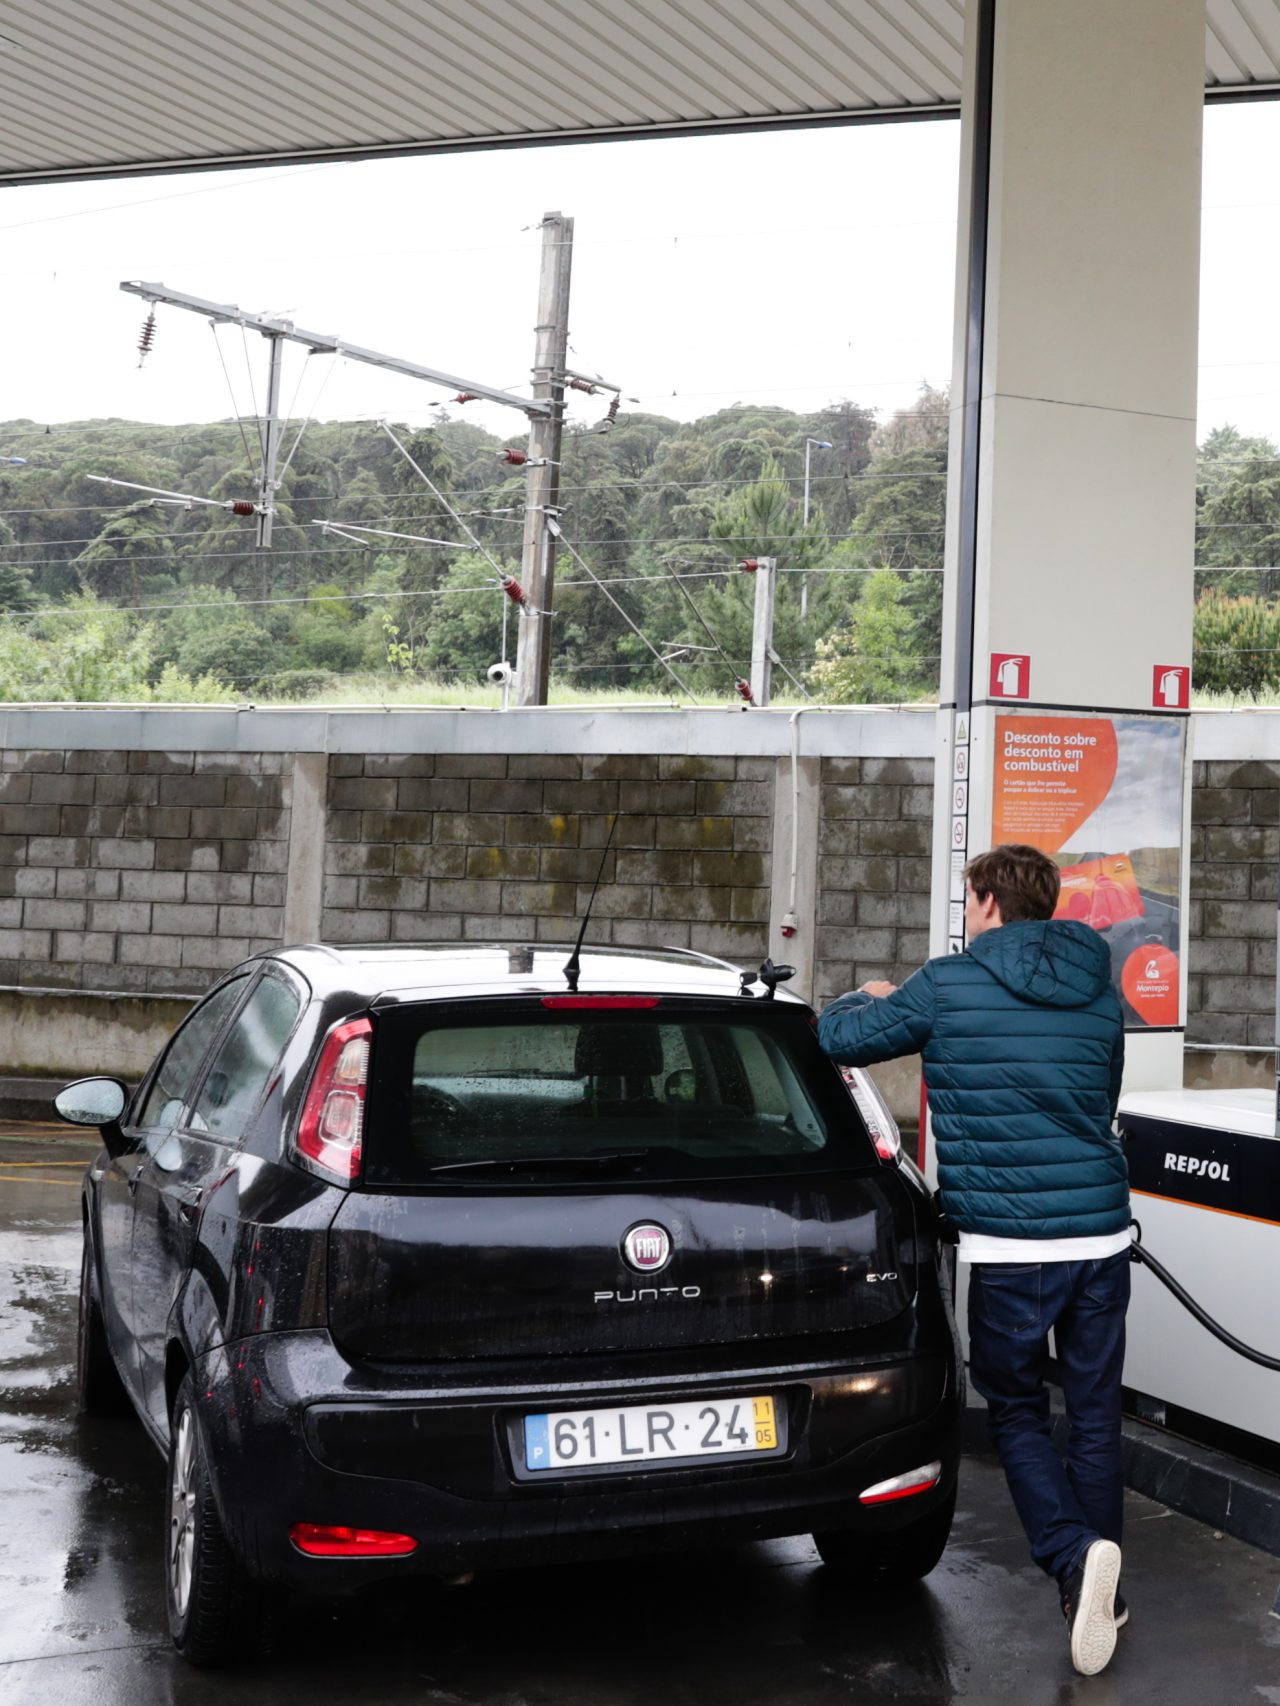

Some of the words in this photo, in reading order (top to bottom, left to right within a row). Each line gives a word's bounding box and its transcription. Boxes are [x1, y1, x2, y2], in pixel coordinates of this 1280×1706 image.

[1004, 731, 1061, 745] Desconto
[1063, 732, 1097, 746] sobre
[1004, 744, 1061, 758] desconto
[1064, 749, 1083, 759] em
[1004, 758, 1079, 773] combustível
[1164, 1152, 1230, 1182] REPSOL
[636, 1237, 660, 1259] FIAT
[866, 1272, 897, 1282] EVO
[594, 1286, 701, 1303] PUNTO
[752, 1402, 771, 1417] 11
[755, 1429, 772, 1444] 05
[533, 1446, 544, 1459] P
